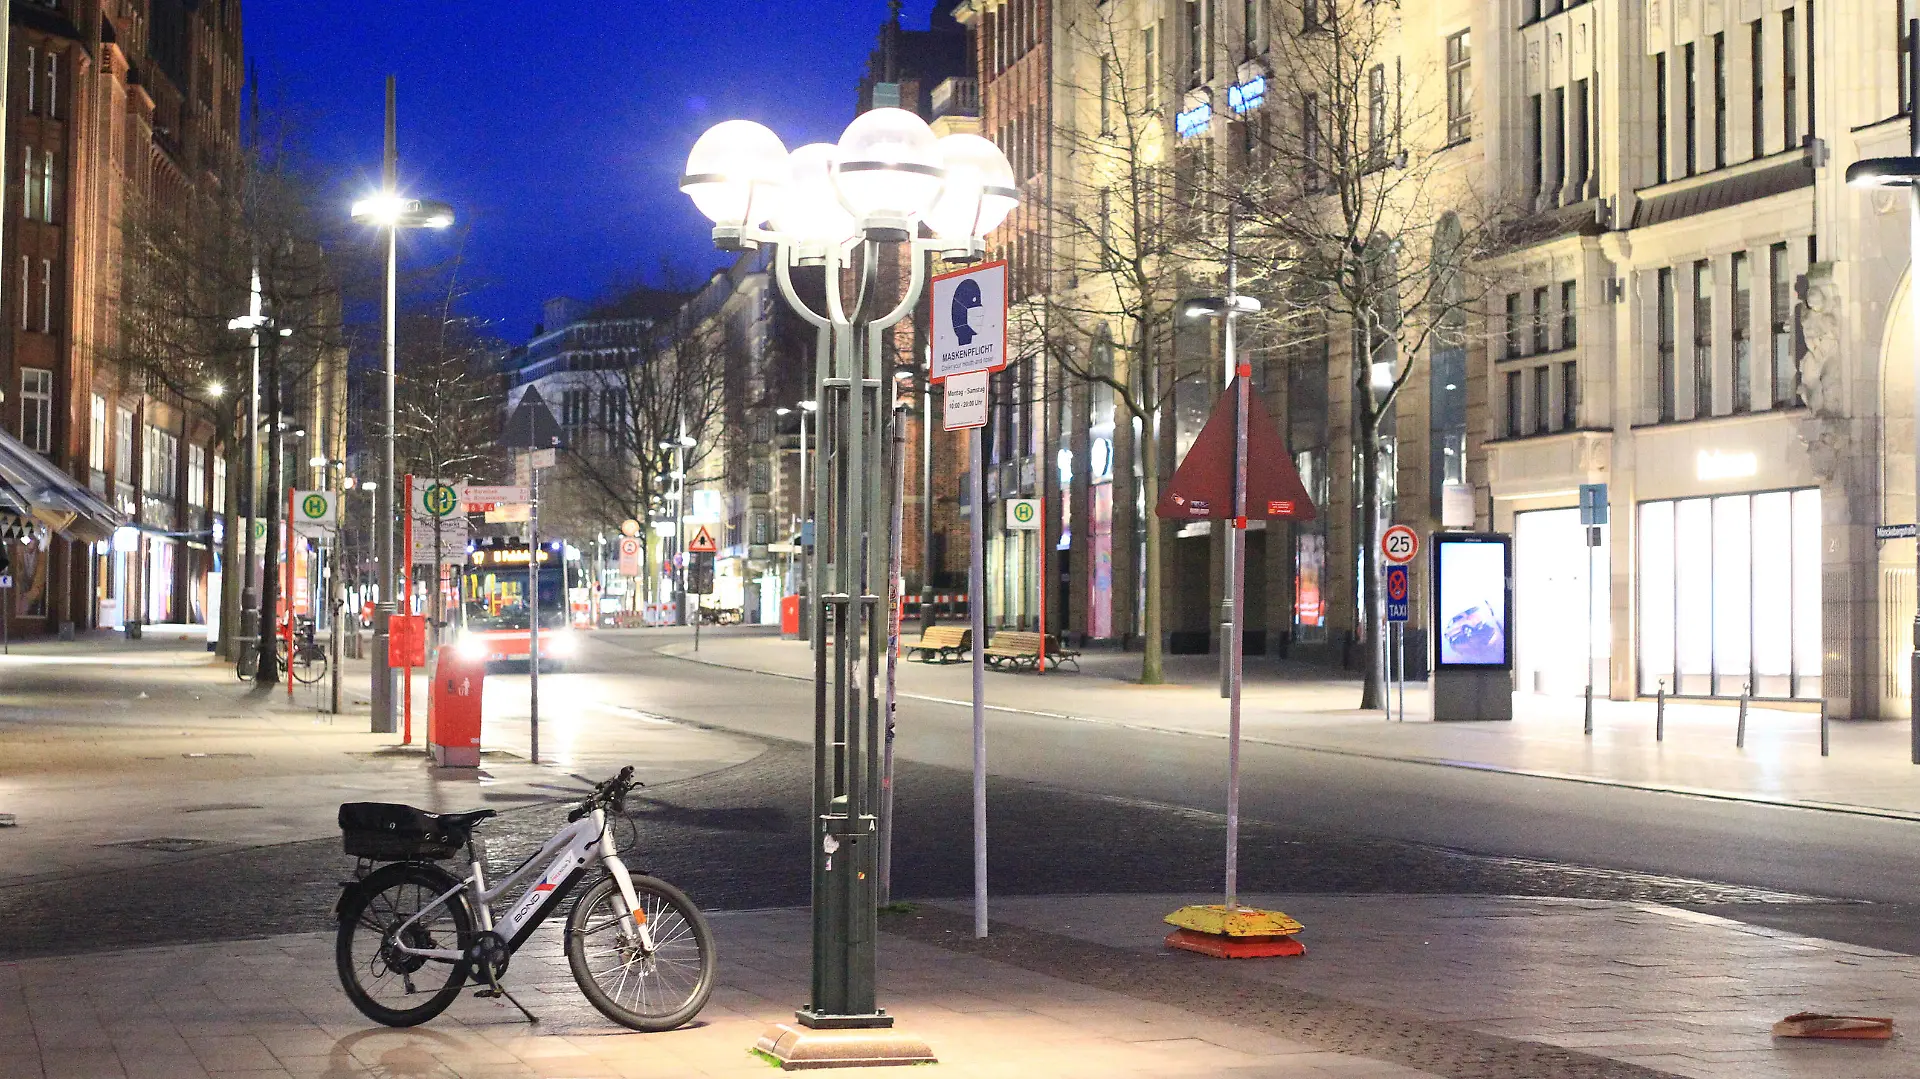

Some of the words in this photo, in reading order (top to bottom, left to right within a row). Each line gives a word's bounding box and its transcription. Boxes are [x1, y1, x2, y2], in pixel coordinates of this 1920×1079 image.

[942, 343, 993, 362] MASKENPFLICHT
[947, 389, 964, 397] Montag
[966, 386, 985, 395] Samstag
[1390, 536, 1410, 553] 25
[1388, 604, 1406, 616] TAXI
[514, 893, 541, 923] BOND
